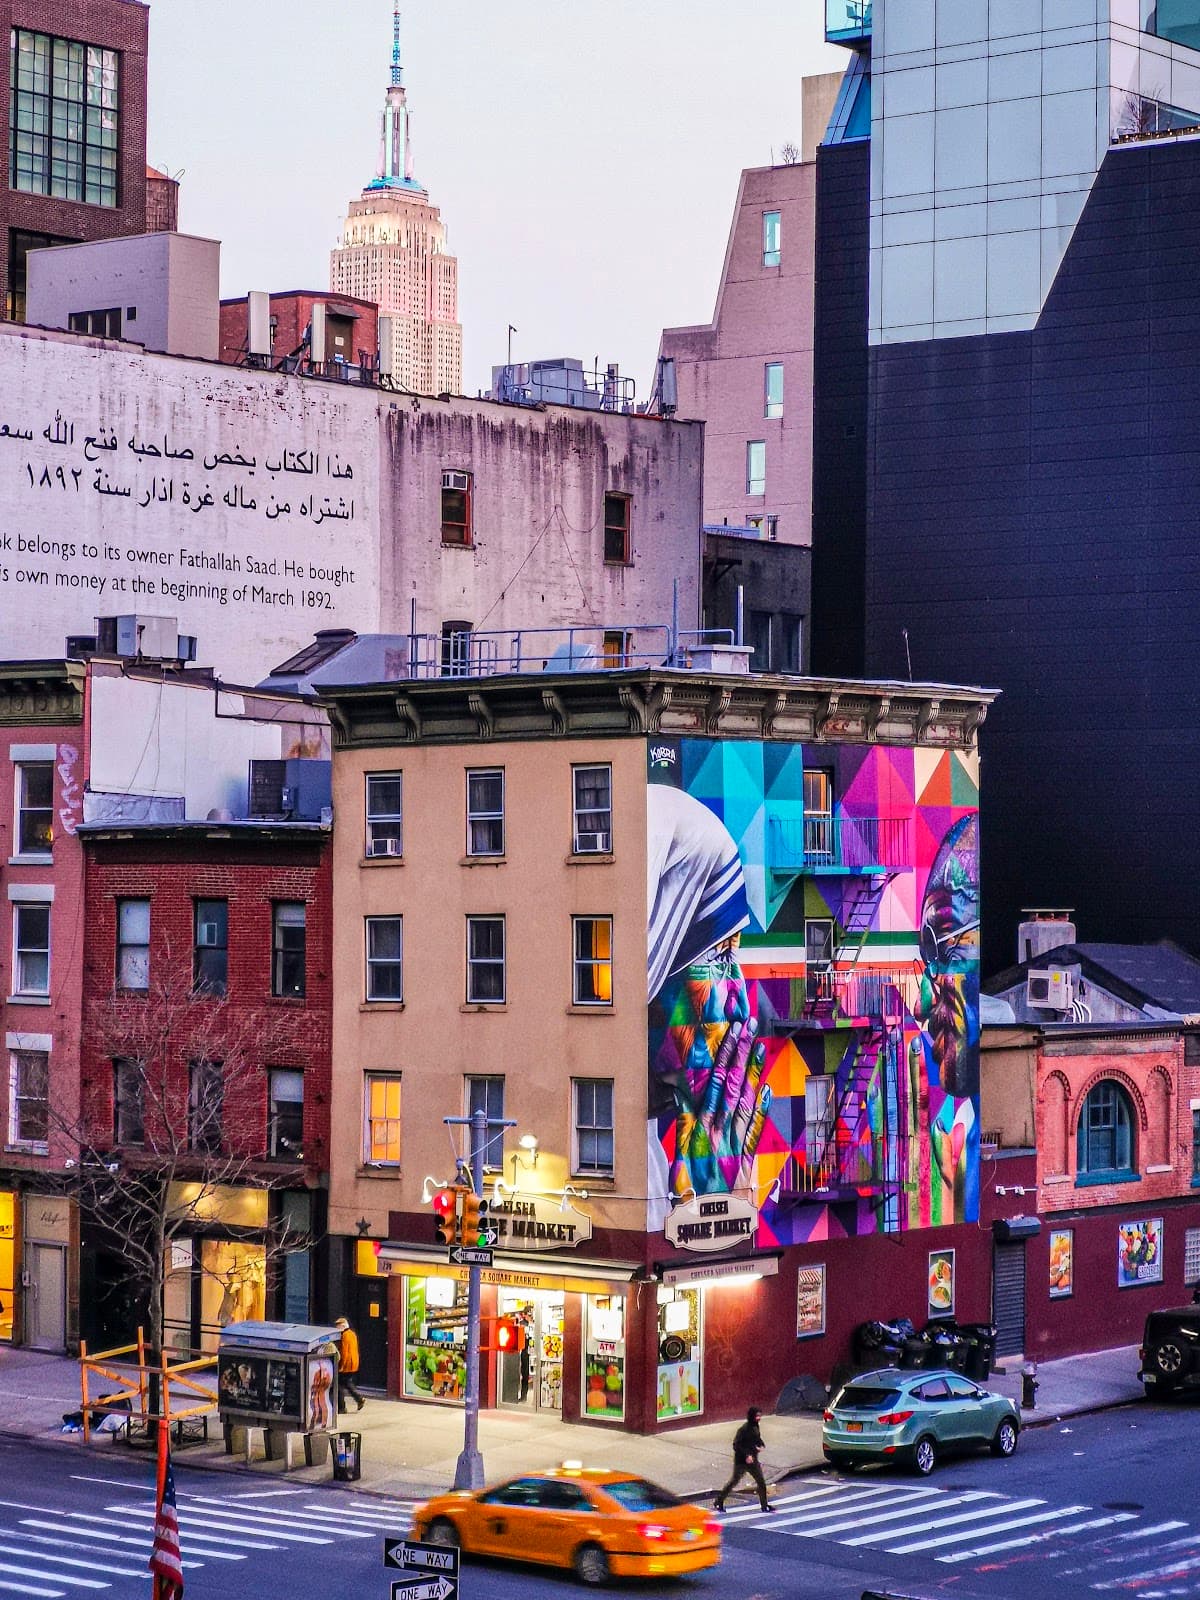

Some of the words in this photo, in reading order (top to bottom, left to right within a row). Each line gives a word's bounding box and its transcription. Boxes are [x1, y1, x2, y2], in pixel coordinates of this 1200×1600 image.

[0, 424, 33, 441] سع
[42, 408, 74, 445] الله
[84, 426, 118, 462] فتح
[127, 432, 194, 463] صاحبه
[203, 444, 257, 477] يخص
[265, 447, 319, 481] الكتاب
[326, 453, 353, 480] هذا
[26, 461, 82, 493] ١٨٩٢
[92, 467, 131, 497] سنة
[137, 476, 173, 508] اذار
[182, 481, 215, 513] غرة
[222, 483, 257, 510] ماله
[265, 495, 291, 519] من
[299, 494, 354, 525] اشتراه
[17, 533, 76, 561] belongs
[82, 543, 99, 558] to
[104, 542, 121, 561] its
[126, 549, 175, 566] owner
[180, 548, 241, 572] Fathallah
[246, 555, 281, 577] Saad.
[284, 559, 305, 578] He
[309, 561, 355, 587] bought
[15, 570, 49, 585] own
[55, 572, 107, 595] money
[111, 577, 127, 592] at
[131, 574, 156, 595] the
[160, 577, 229, 606] beginning
[232, 584, 248, 602] of
[252, 585, 294, 607] March
[301, 589, 336, 611] 1892.
[512, 1219, 577, 1242] MARKET
[677, 1220, 713, 1244] SQUARE
[713, 1216, 752, 1239] MARKET
[455, 1251, 470, 1260] ONE
[474, 1253, 489, 1263] WAY
[513, 1275, 540, 1287] MARKET
[599, 1343, 615, 1351] ATM
[395, 1548, 416, 1563] ONE
[426, 1552, 449, 1568] WAY
[400, 1587, 420, 1600] ONE
[427, 1583, 448, 1598] WAY
